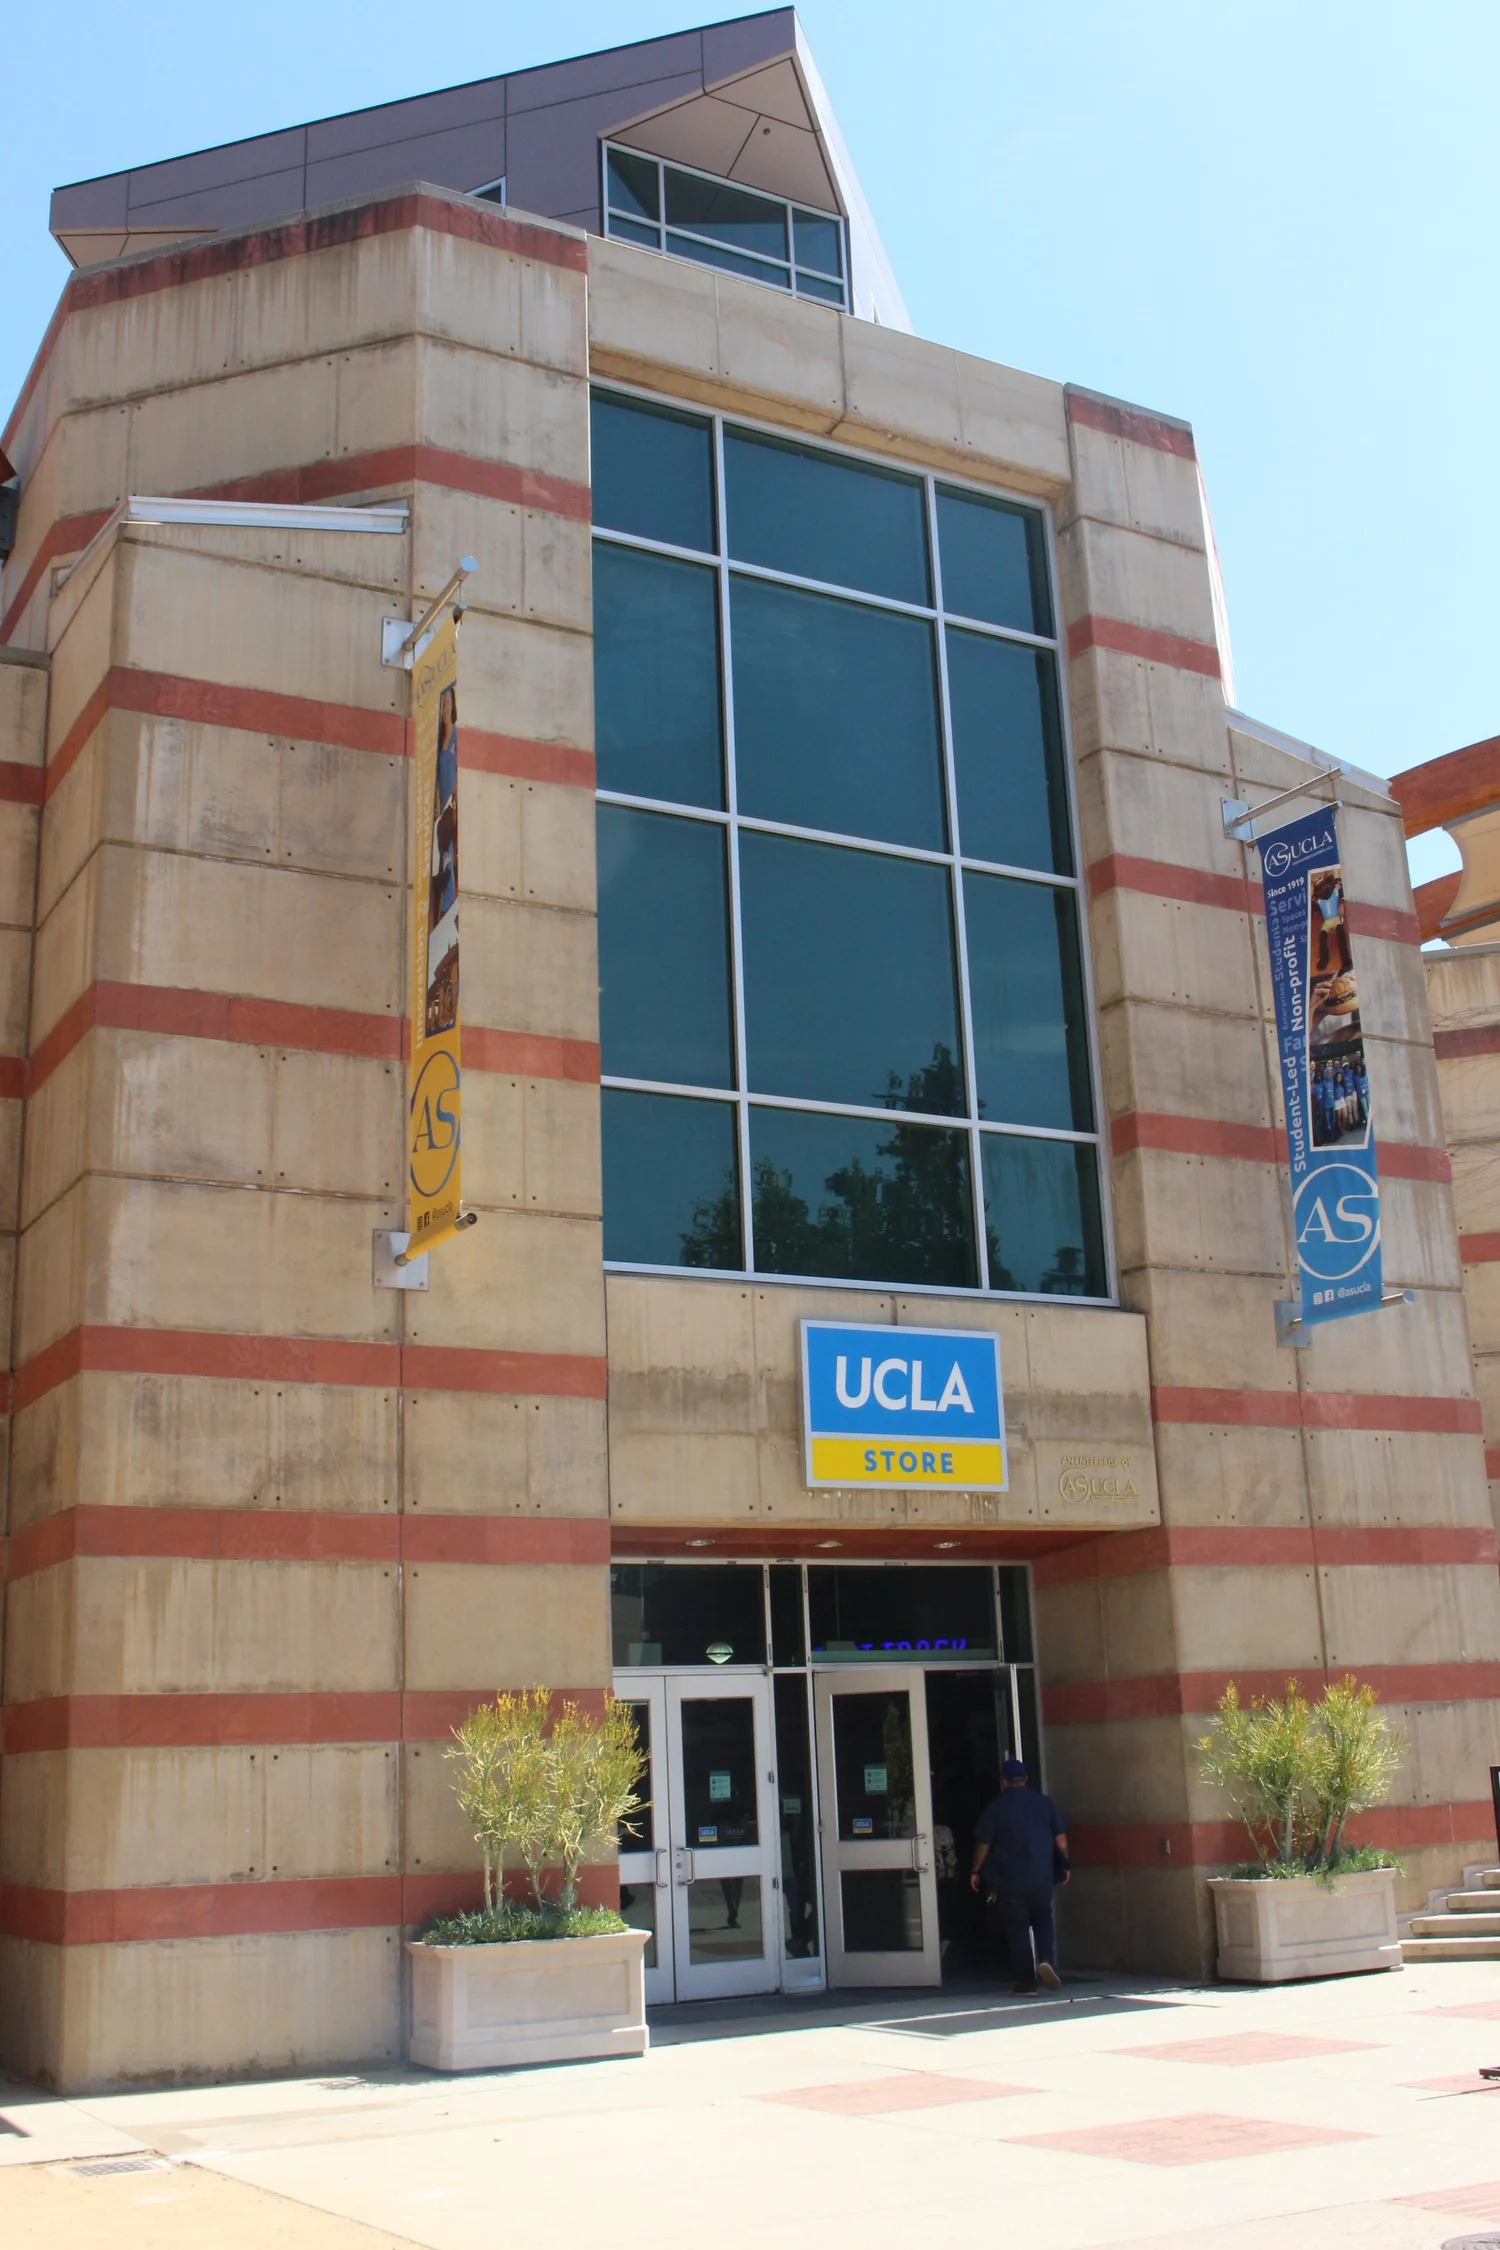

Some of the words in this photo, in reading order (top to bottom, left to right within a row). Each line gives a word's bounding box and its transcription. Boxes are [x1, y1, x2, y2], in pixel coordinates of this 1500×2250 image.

[1264, 831, 1333, 877] ASUCLA
[1267, 886, 1286, 899] Since
[1287, 876, 1305, 891] 1919
[1281, 909, 1306, 924] Spaces
[1271, 917, 1284, 982] Students
[415, 926, 424, 1049] Innovation
[1284, 934, 1304, 1032] Non-profit
[1283, 1055, 1306, 1173] Student-Led
[1337, 1281, 1371, 1298] @asucla
[836, 1355, 975, 1413] UCLA
[864, 1449, 954, 1474] STORE
[1059, 1468, 1139, 1504] ASUCLA
